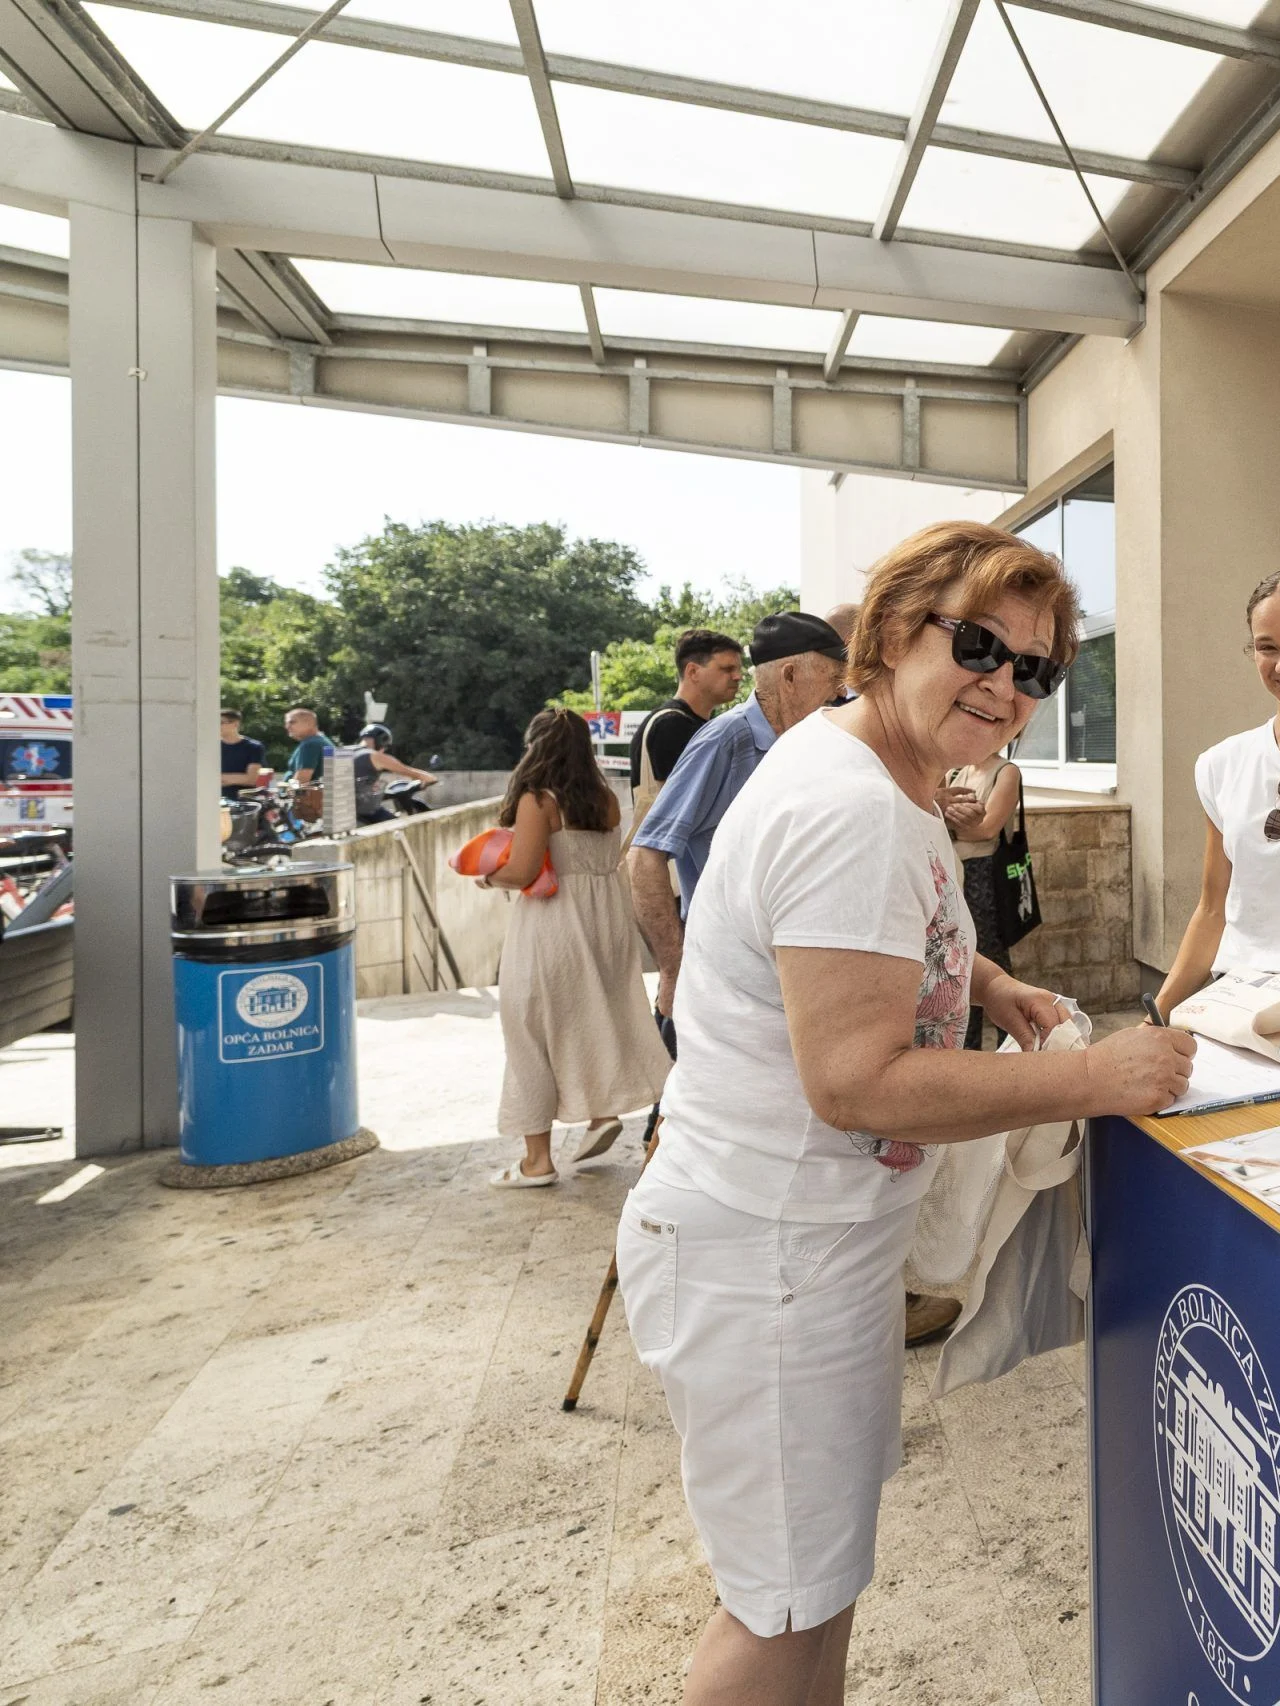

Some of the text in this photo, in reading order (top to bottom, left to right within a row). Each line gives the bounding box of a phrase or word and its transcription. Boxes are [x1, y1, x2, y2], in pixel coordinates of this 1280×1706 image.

[248, 1040, 294, 1056] ZADAR
[263, 1024, 320, 1042] BOLNICA
[1177, 1292, 1254, 1386] BOLNICA
[1198, 1614, 1236, 1690] 1887
